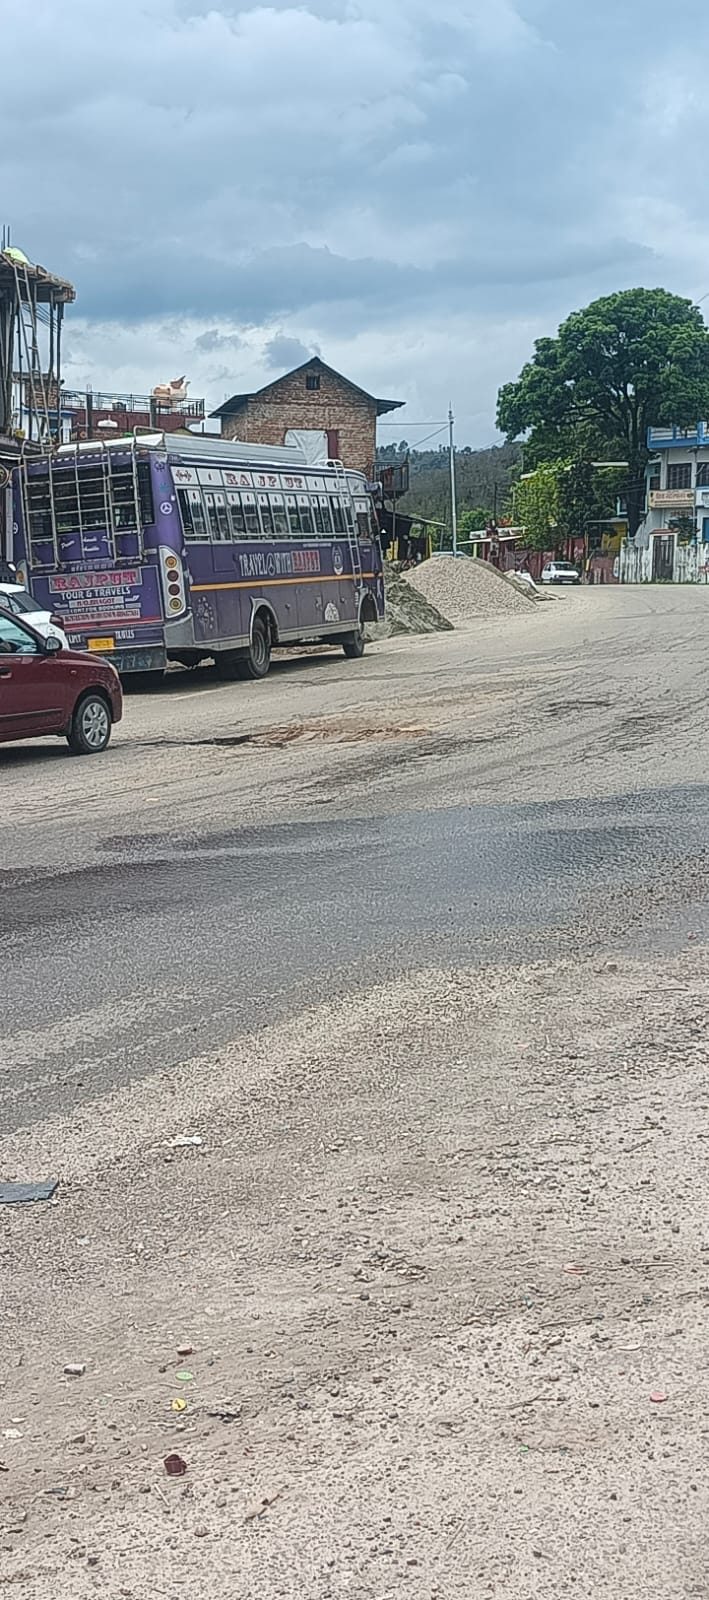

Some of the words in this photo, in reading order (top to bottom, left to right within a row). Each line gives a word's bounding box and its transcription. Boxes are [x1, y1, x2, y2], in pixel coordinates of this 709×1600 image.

[239, 553, 268, 577] TRAVEL
[54, 572, 136, 590] RAJPUT
[61, 592, 85, 600] TOUR
[86, 590, 93, 598] &
[94, 586, 131, 597] TRAVELS
